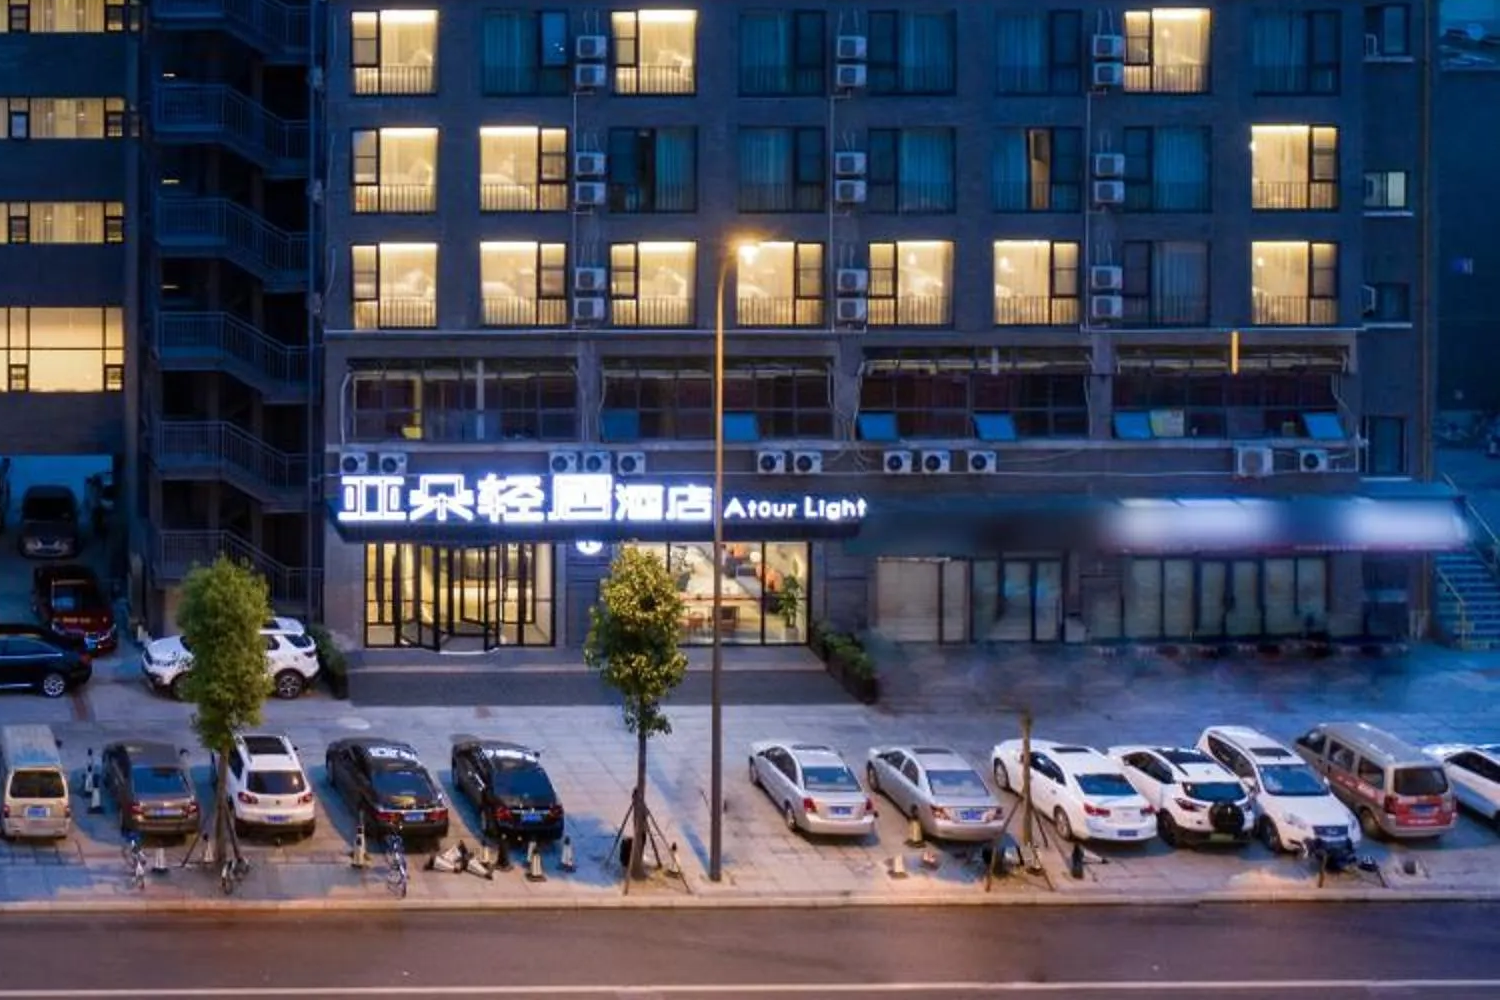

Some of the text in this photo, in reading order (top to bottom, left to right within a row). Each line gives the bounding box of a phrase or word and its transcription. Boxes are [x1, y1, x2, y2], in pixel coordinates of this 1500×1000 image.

[337, 473, 713, 523] 亚朵轻居酒店
[723, 496, 867, 520] Atour Light
